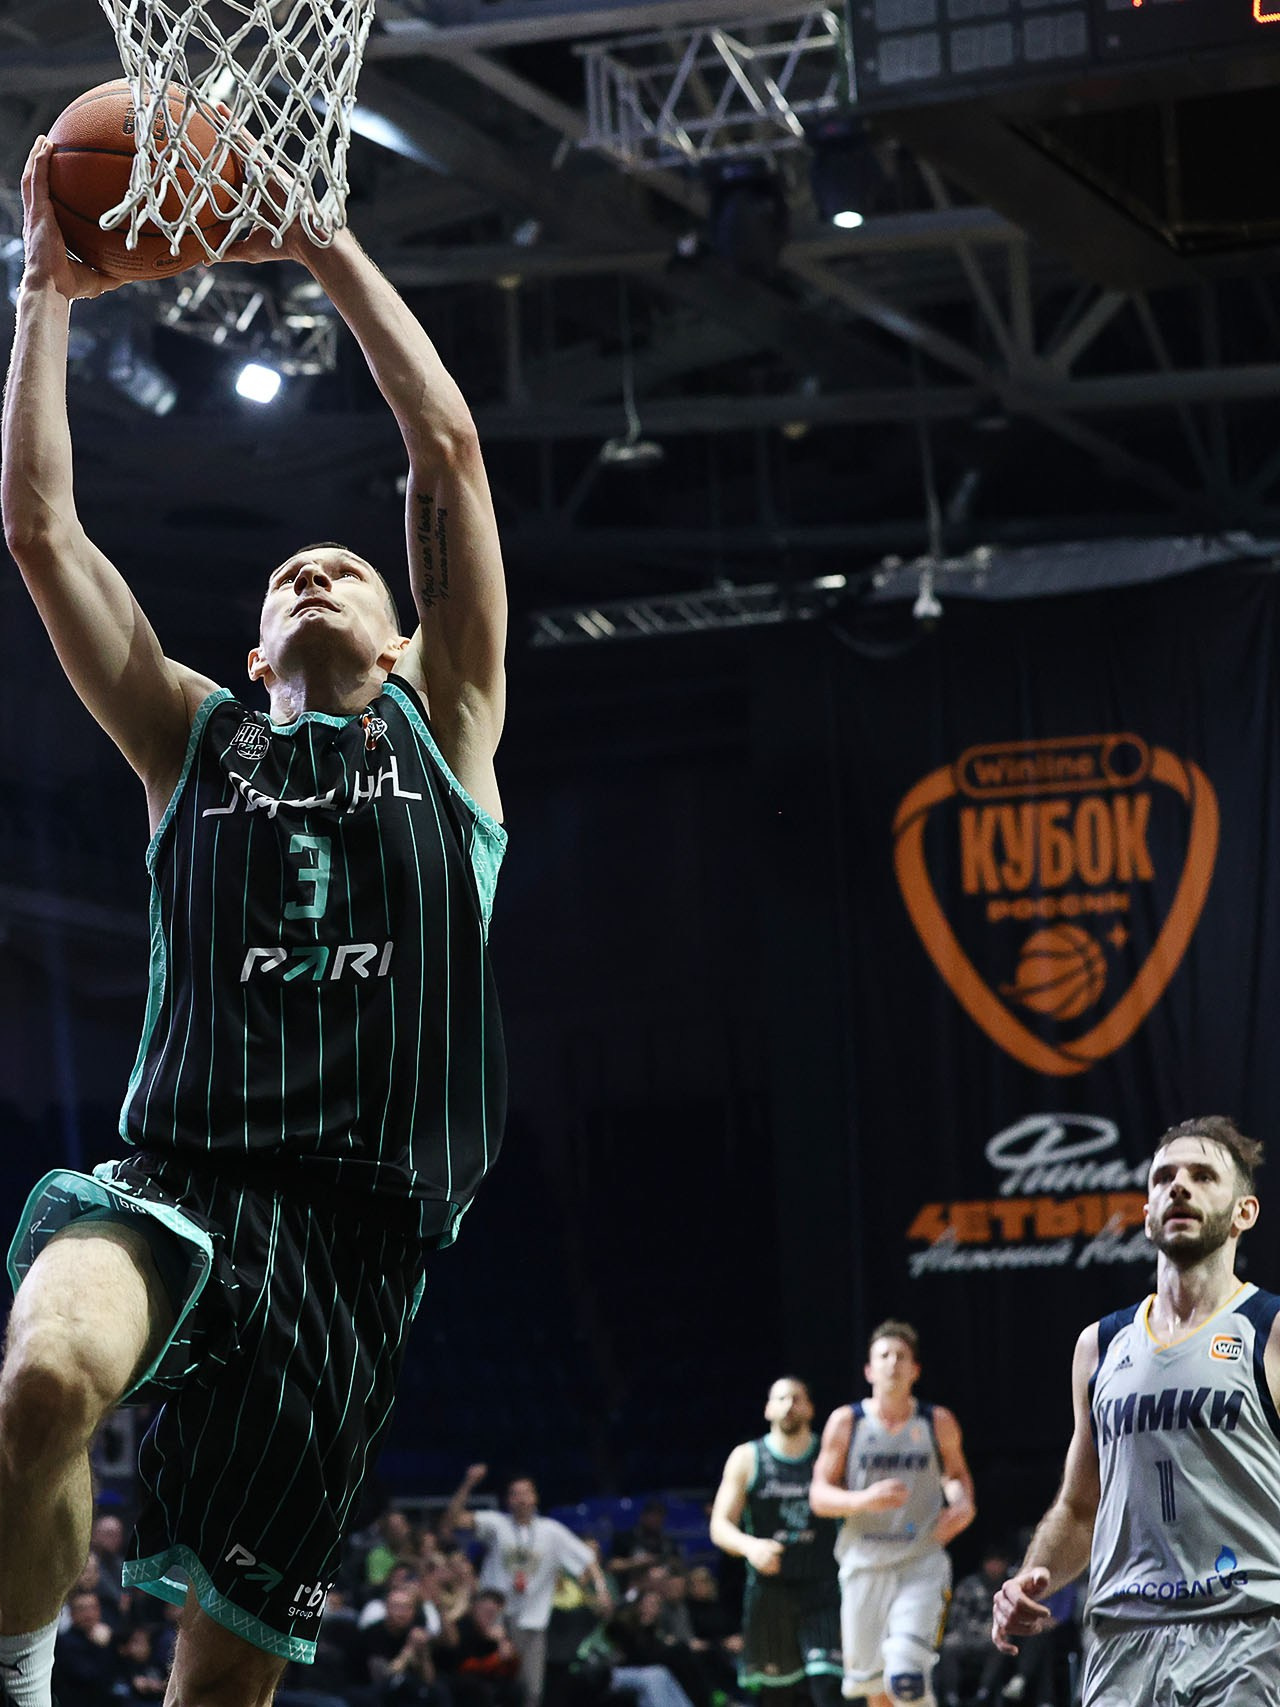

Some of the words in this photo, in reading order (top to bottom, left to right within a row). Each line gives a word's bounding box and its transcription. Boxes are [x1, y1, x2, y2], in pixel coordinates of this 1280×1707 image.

[958, 791, 1156, 897] КУБОК
[283, 833, 332, 920] 3
[239, 940, 395, 983] PARI
[1154, 1459, 1177, 1523] 1
[287, 1605, 314, 1621] group
